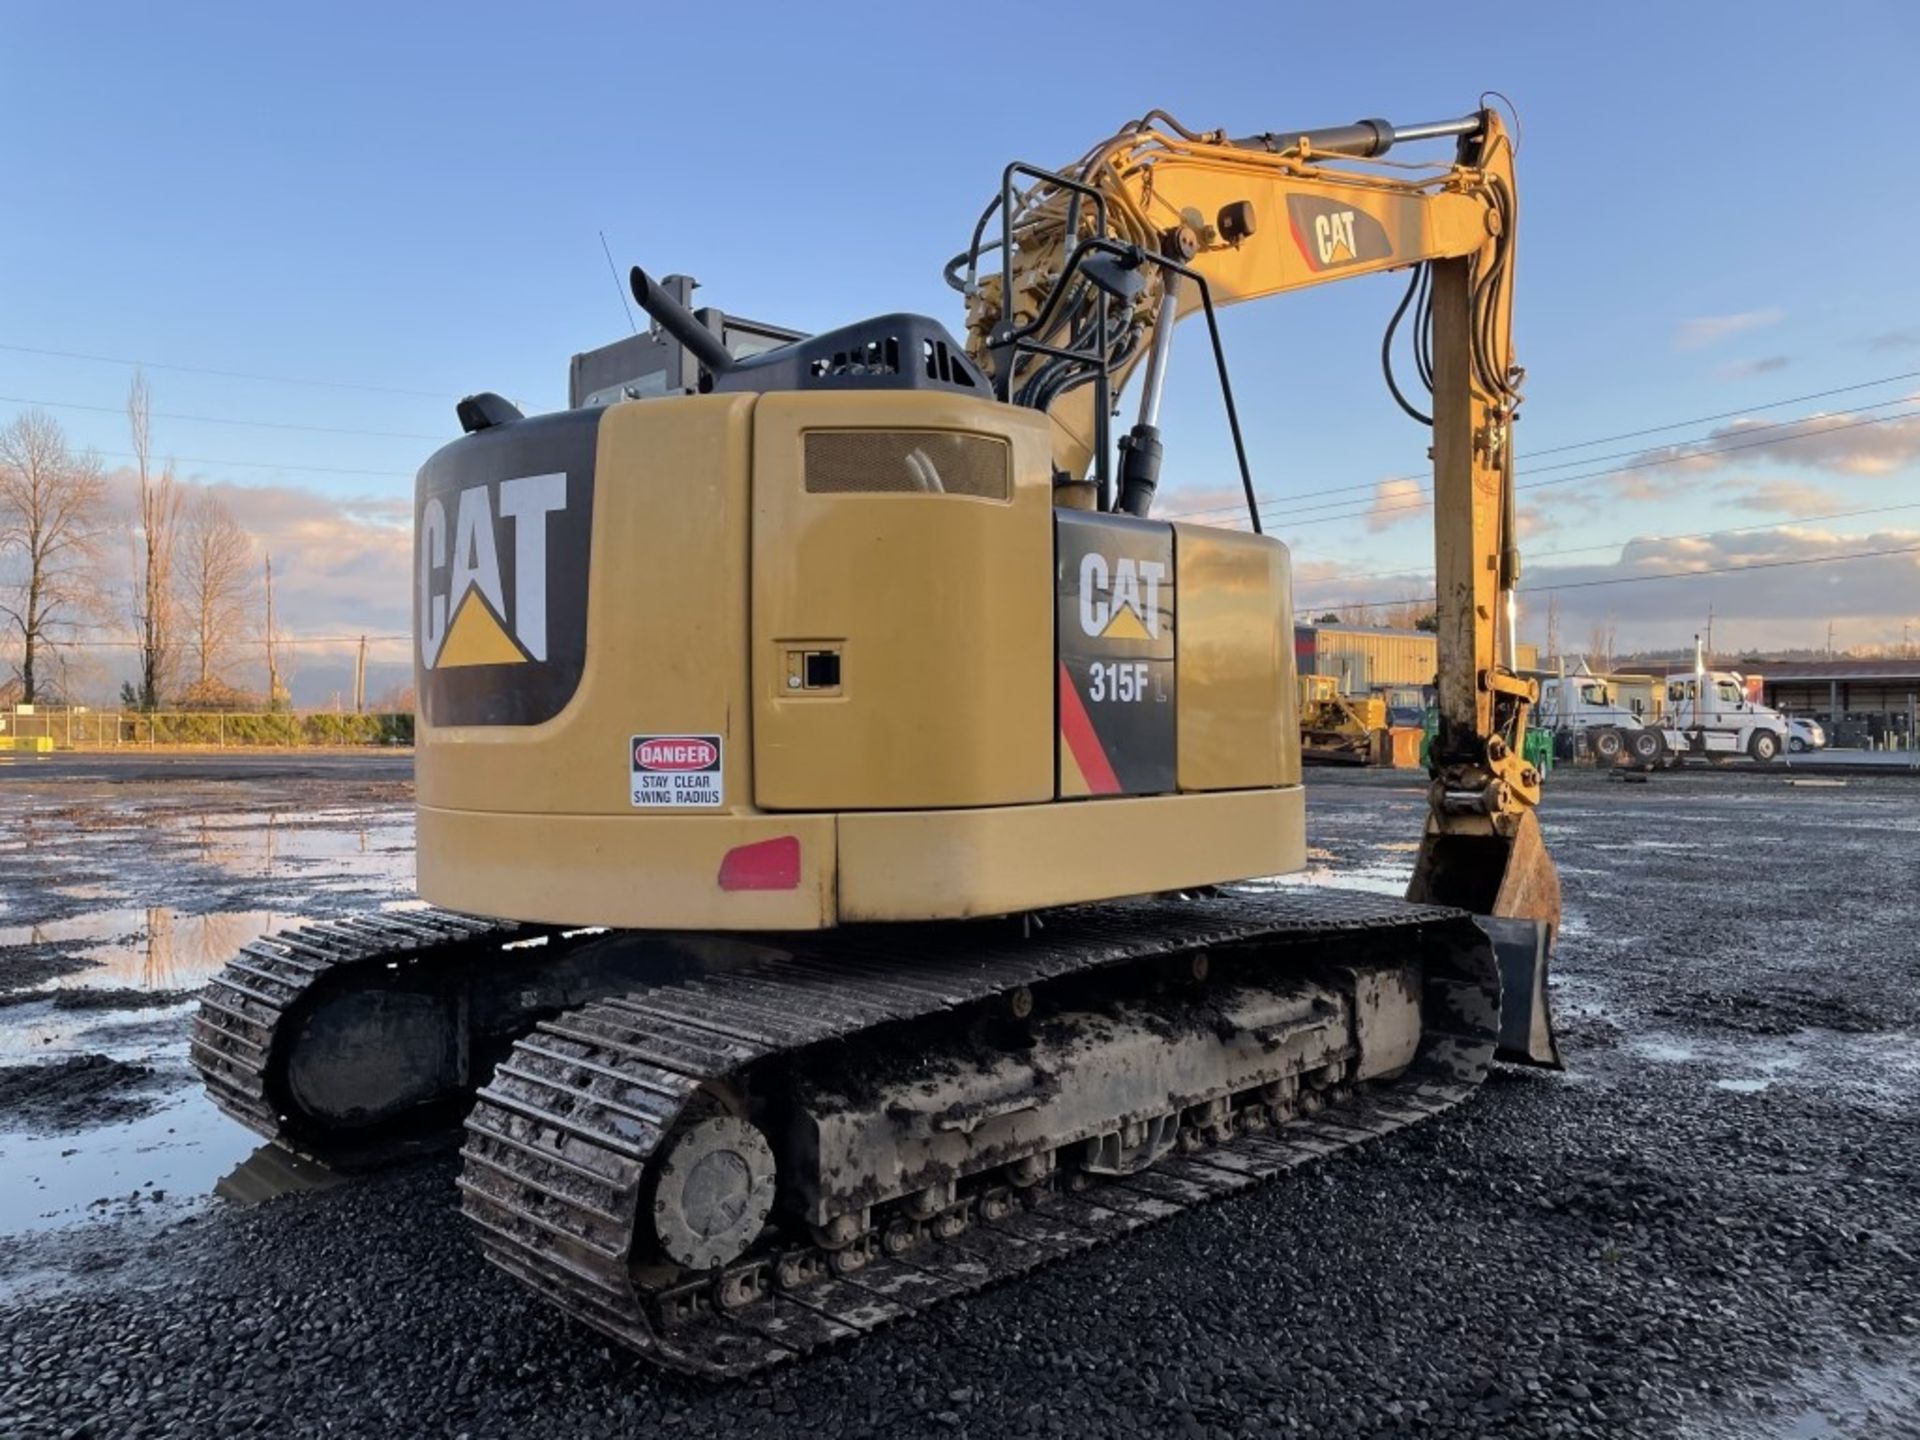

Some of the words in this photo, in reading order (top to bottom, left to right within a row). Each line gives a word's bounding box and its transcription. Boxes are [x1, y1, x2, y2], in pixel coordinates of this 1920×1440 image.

[1315, 211, 1357, 264] CAT
[421, 472, 567, 670] CAT
[1079, 552, 1165, 641] CAT
[1089, 661, 1148, 702] 315F
[640, 746, 711, 763] DANGER
[633, 790, 671, 803] SWING
[676, 790, 719, 803] RADIUS
[642, 775, 668, 788] STAY
[674, 775, 710, 788] CLEAR
